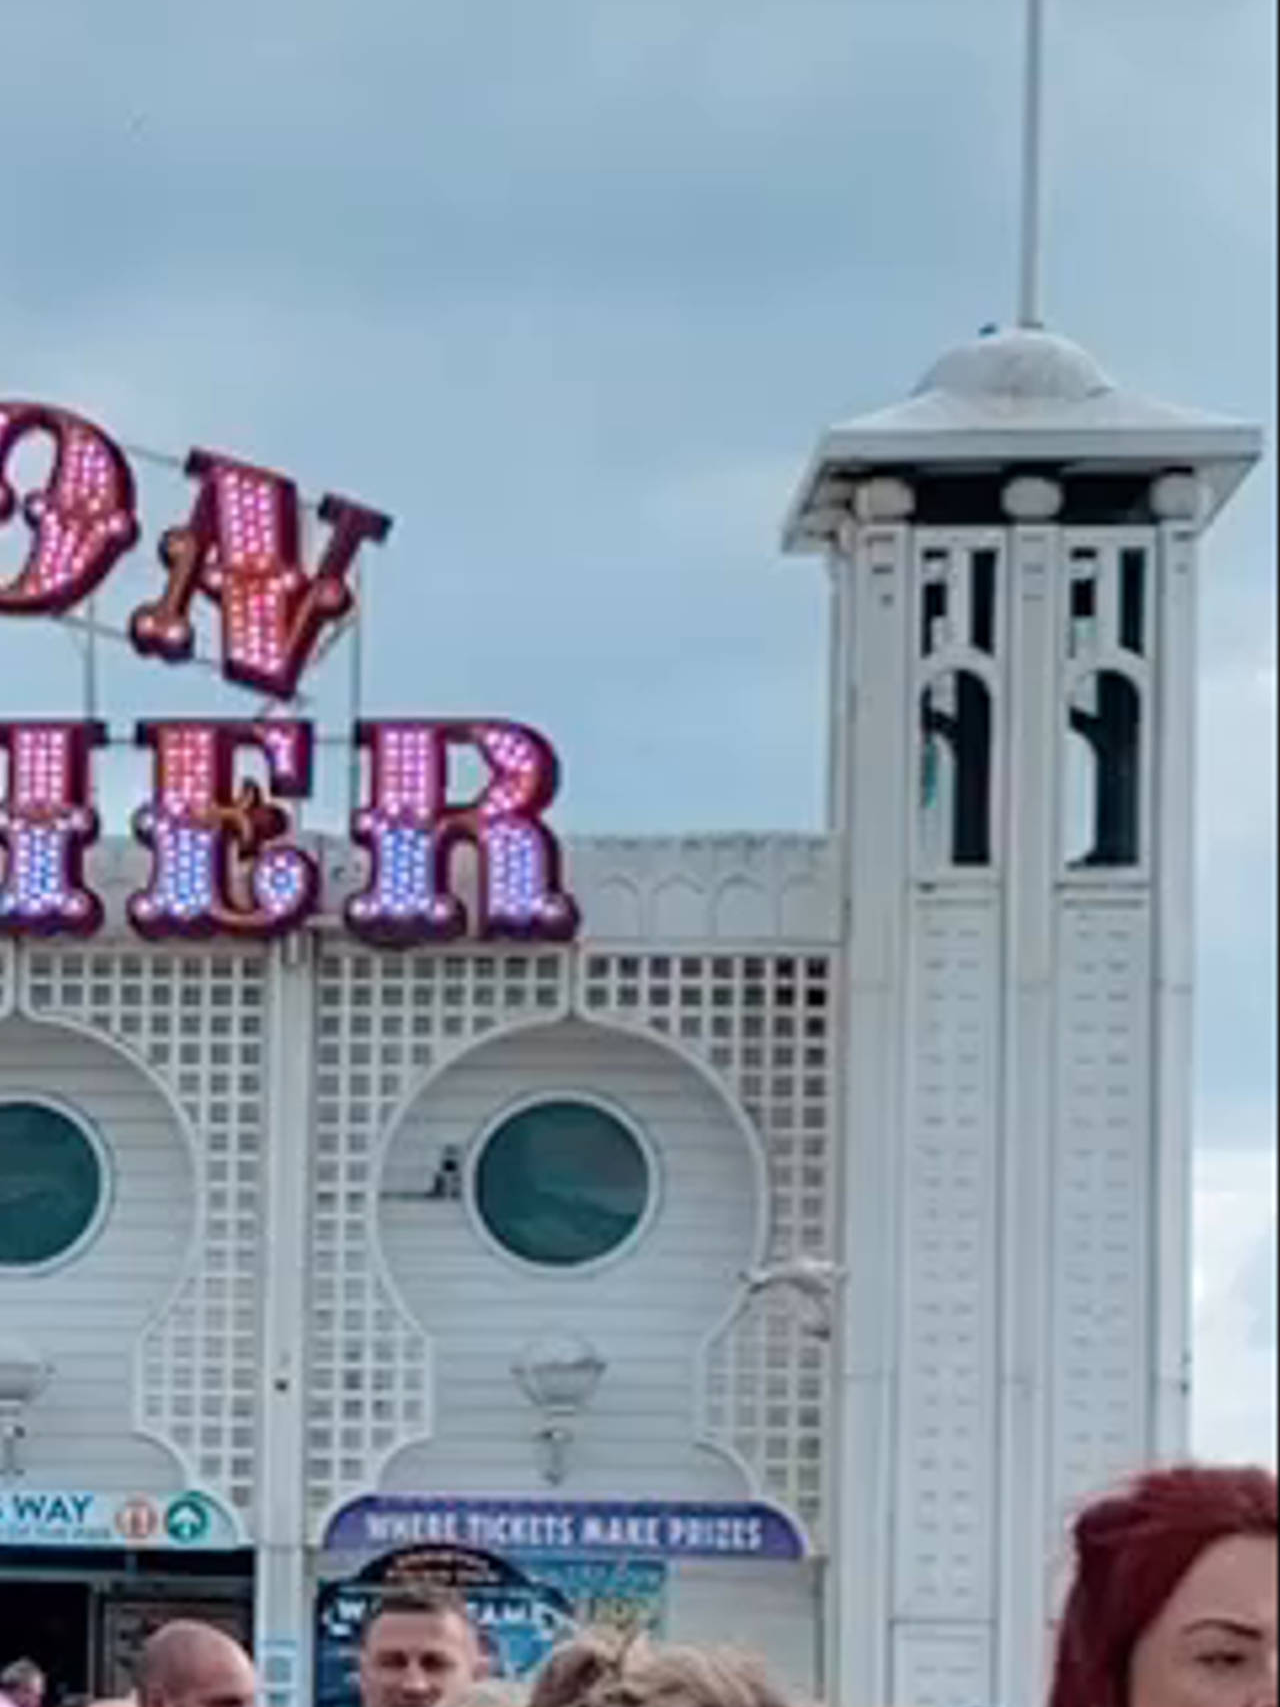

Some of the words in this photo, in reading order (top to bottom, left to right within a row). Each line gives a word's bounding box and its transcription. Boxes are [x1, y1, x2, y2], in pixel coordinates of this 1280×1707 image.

[11, 1494, 94, 1525] WAY
[365, 1512, 460, 1543] WHERE
[467, 1513, 573, 1546] TICKETS
[581, 1516, 660, 1548] MAKE
[668, 1517, 764, 1551] PRIZES
